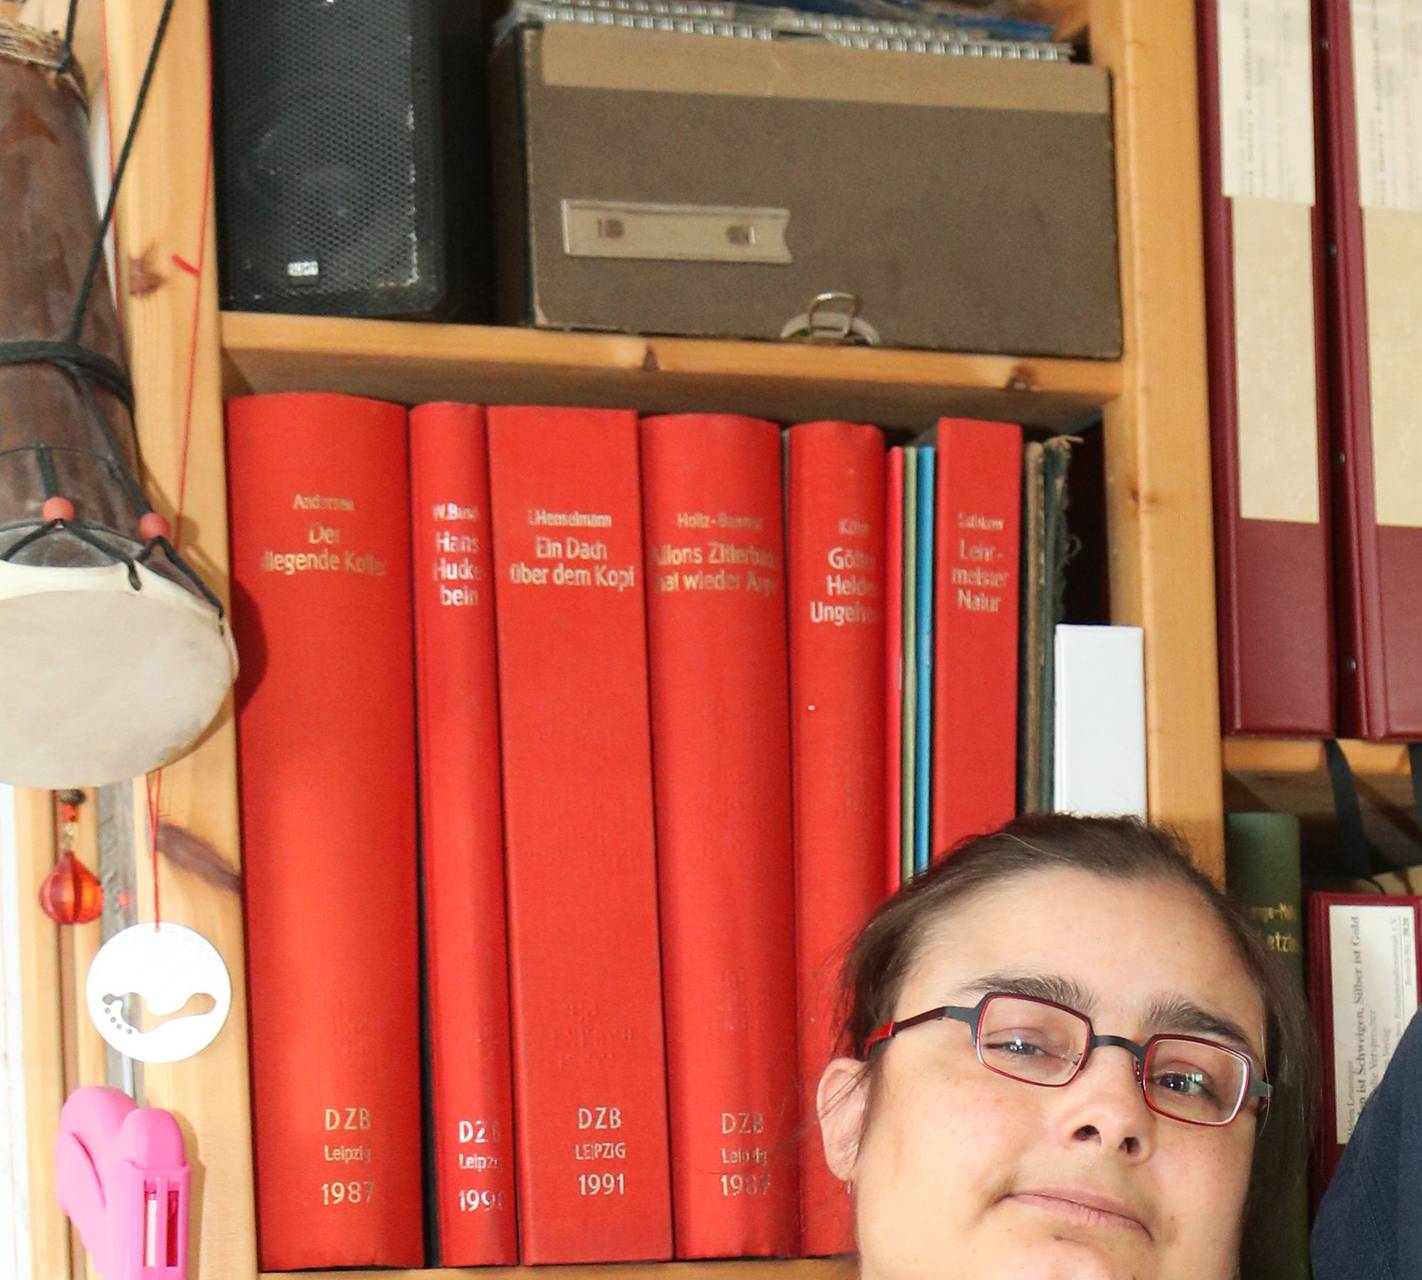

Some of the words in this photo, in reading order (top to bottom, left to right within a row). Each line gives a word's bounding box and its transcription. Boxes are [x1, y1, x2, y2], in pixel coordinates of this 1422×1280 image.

[435, 531, 480, 554] Hans
[535, 537, 563, 559] Ein
[566, 537, 607, 560] Dach
[553, 562, 591, 586] dem
[594, 564, 635, 592] Kopf
[440, 584, 480, 606] bein
[1350, 915, 1361, 947] Gold
[1354, 967, 1363, 1004] Silber
[1356, 1007, 1366, 1075] Schweigen,
[1358, 1079, 1366, 1093] ist
[324, 1106, 371, 1131] DZB
[578, 1107, 623, 1130] DZB
[721, 1112, 765, 1135] DZB
[323, 1144, 371, 1165] Leipzig
[575, 1142, 626, 1160] LEIPZIG
[321, 1181, 375, 1206] 1987
[578, 1172, 625, 1196] 1991
